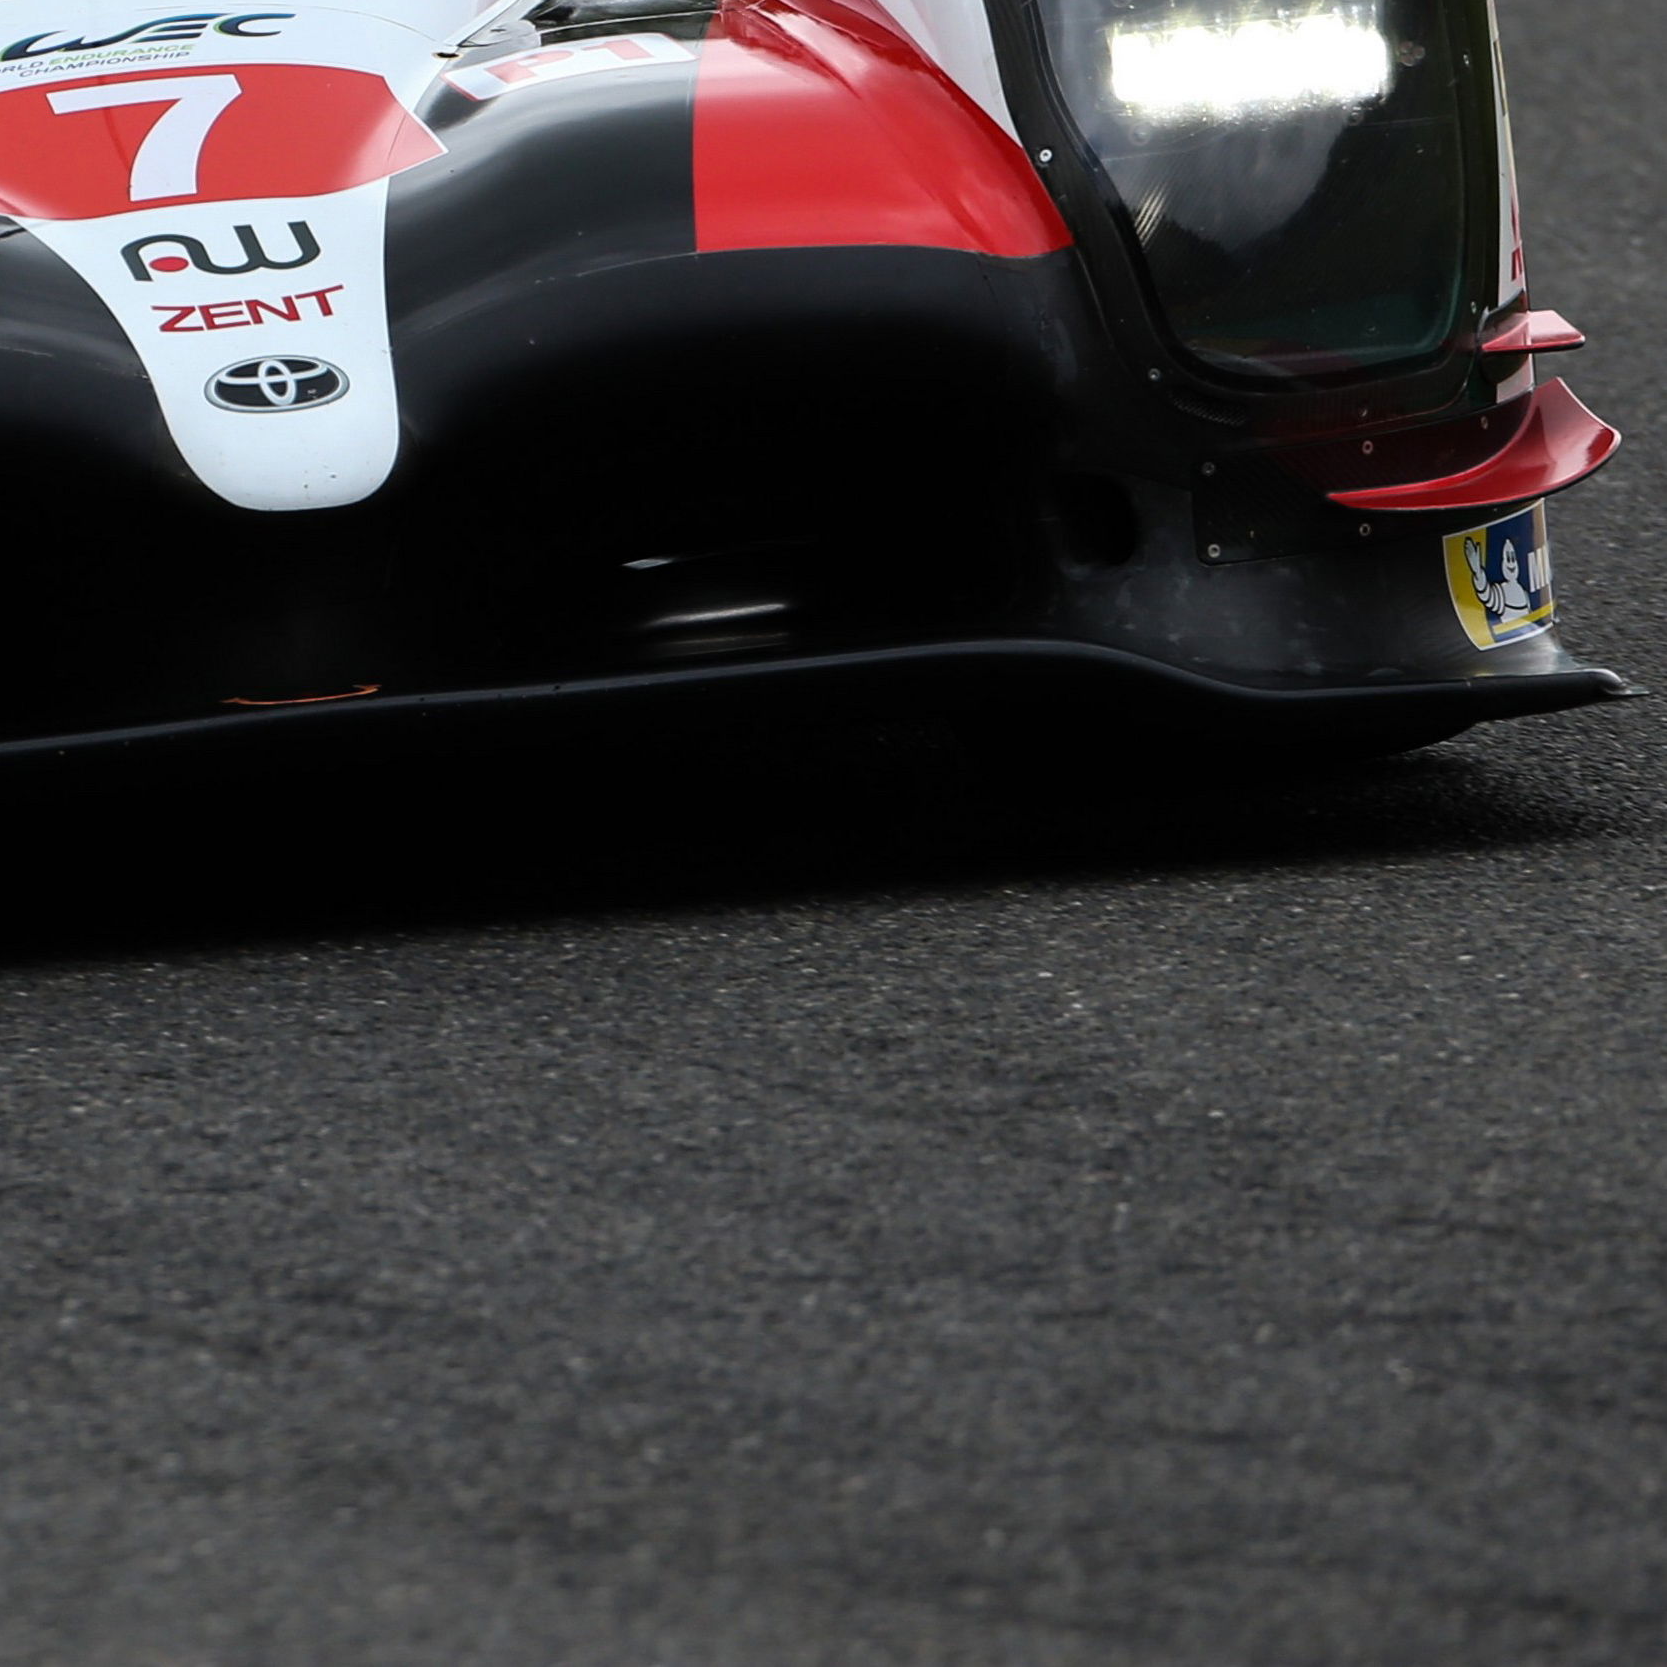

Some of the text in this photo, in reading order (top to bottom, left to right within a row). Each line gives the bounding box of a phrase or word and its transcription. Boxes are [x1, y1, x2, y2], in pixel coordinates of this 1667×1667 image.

[19, 51, 191, 78] CHAMPIONSHIP
[49, 44, 196, 65] ENDURANCE
[484, 38, 655, 84] P1
[45, 73, 244, 202] 7
[151, 284, 344, 332] ZENT
